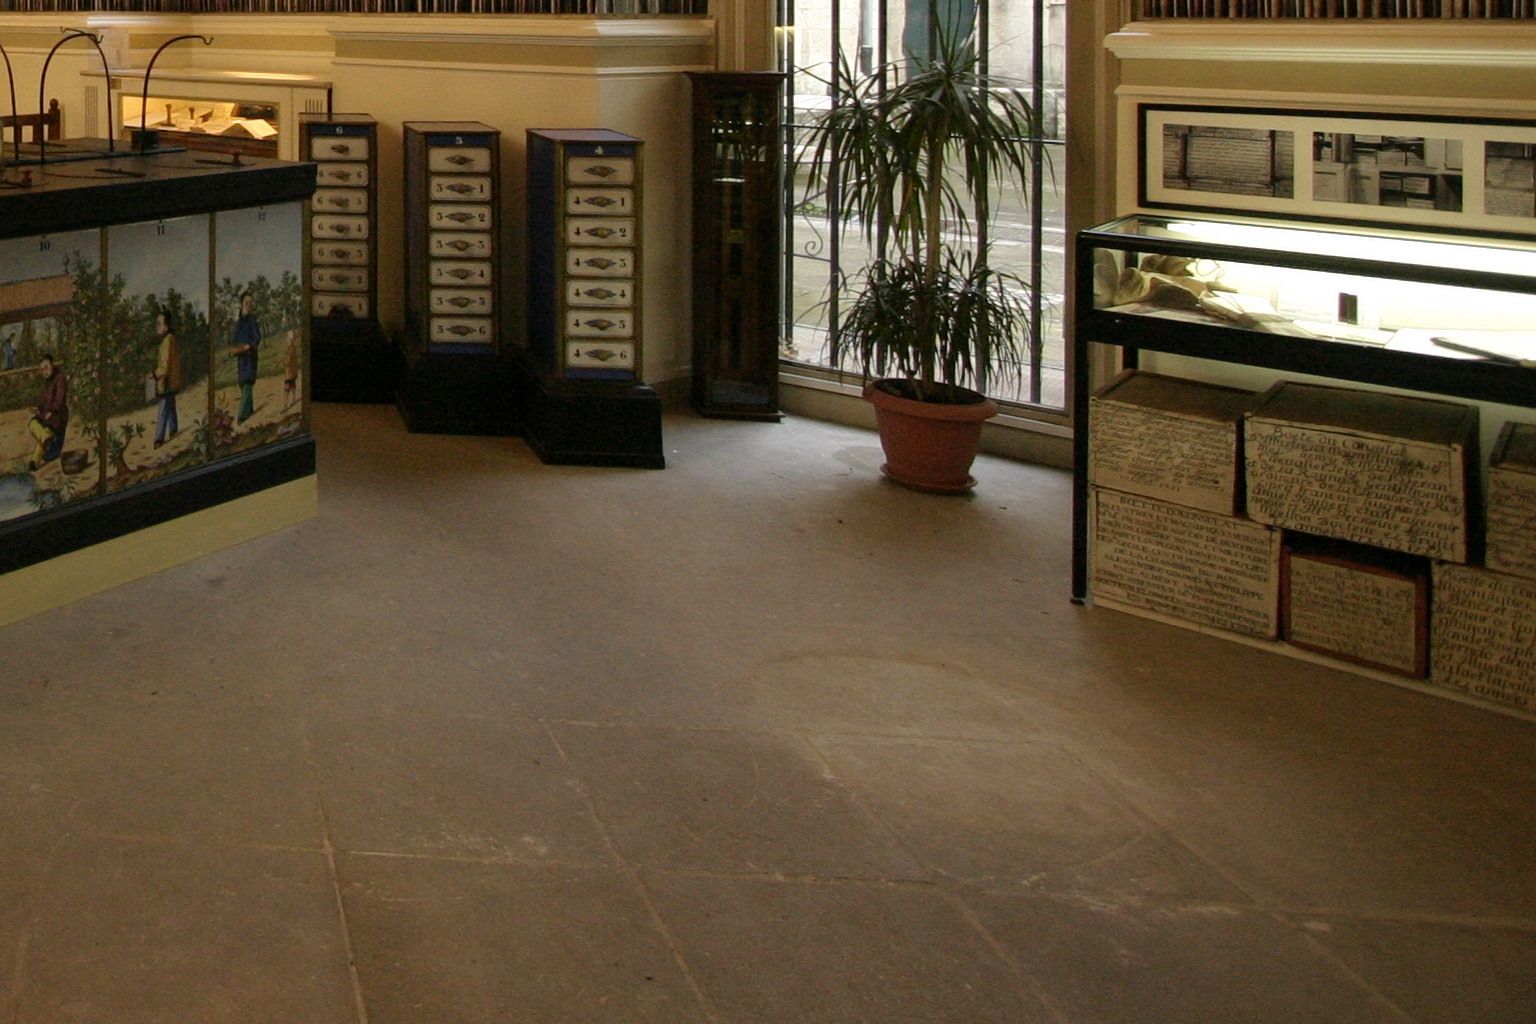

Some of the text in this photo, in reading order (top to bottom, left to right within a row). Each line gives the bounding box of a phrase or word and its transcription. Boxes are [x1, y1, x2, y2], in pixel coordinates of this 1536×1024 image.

[478, 183, 485, 194] 1
[573, 196, 626, 207] 4 1
[478, 212, 486, 223] 2
[573, 226, 627, 238] 4 2
[574, 257, 581, 267] 4
[478, 268, 486, 278] 4
[574, 288, 627, 299] 4 4
[573, 318, 581, 328] 4
[478, 325, 486, 335] 6
[573, 349, 627, 360] 4 6
